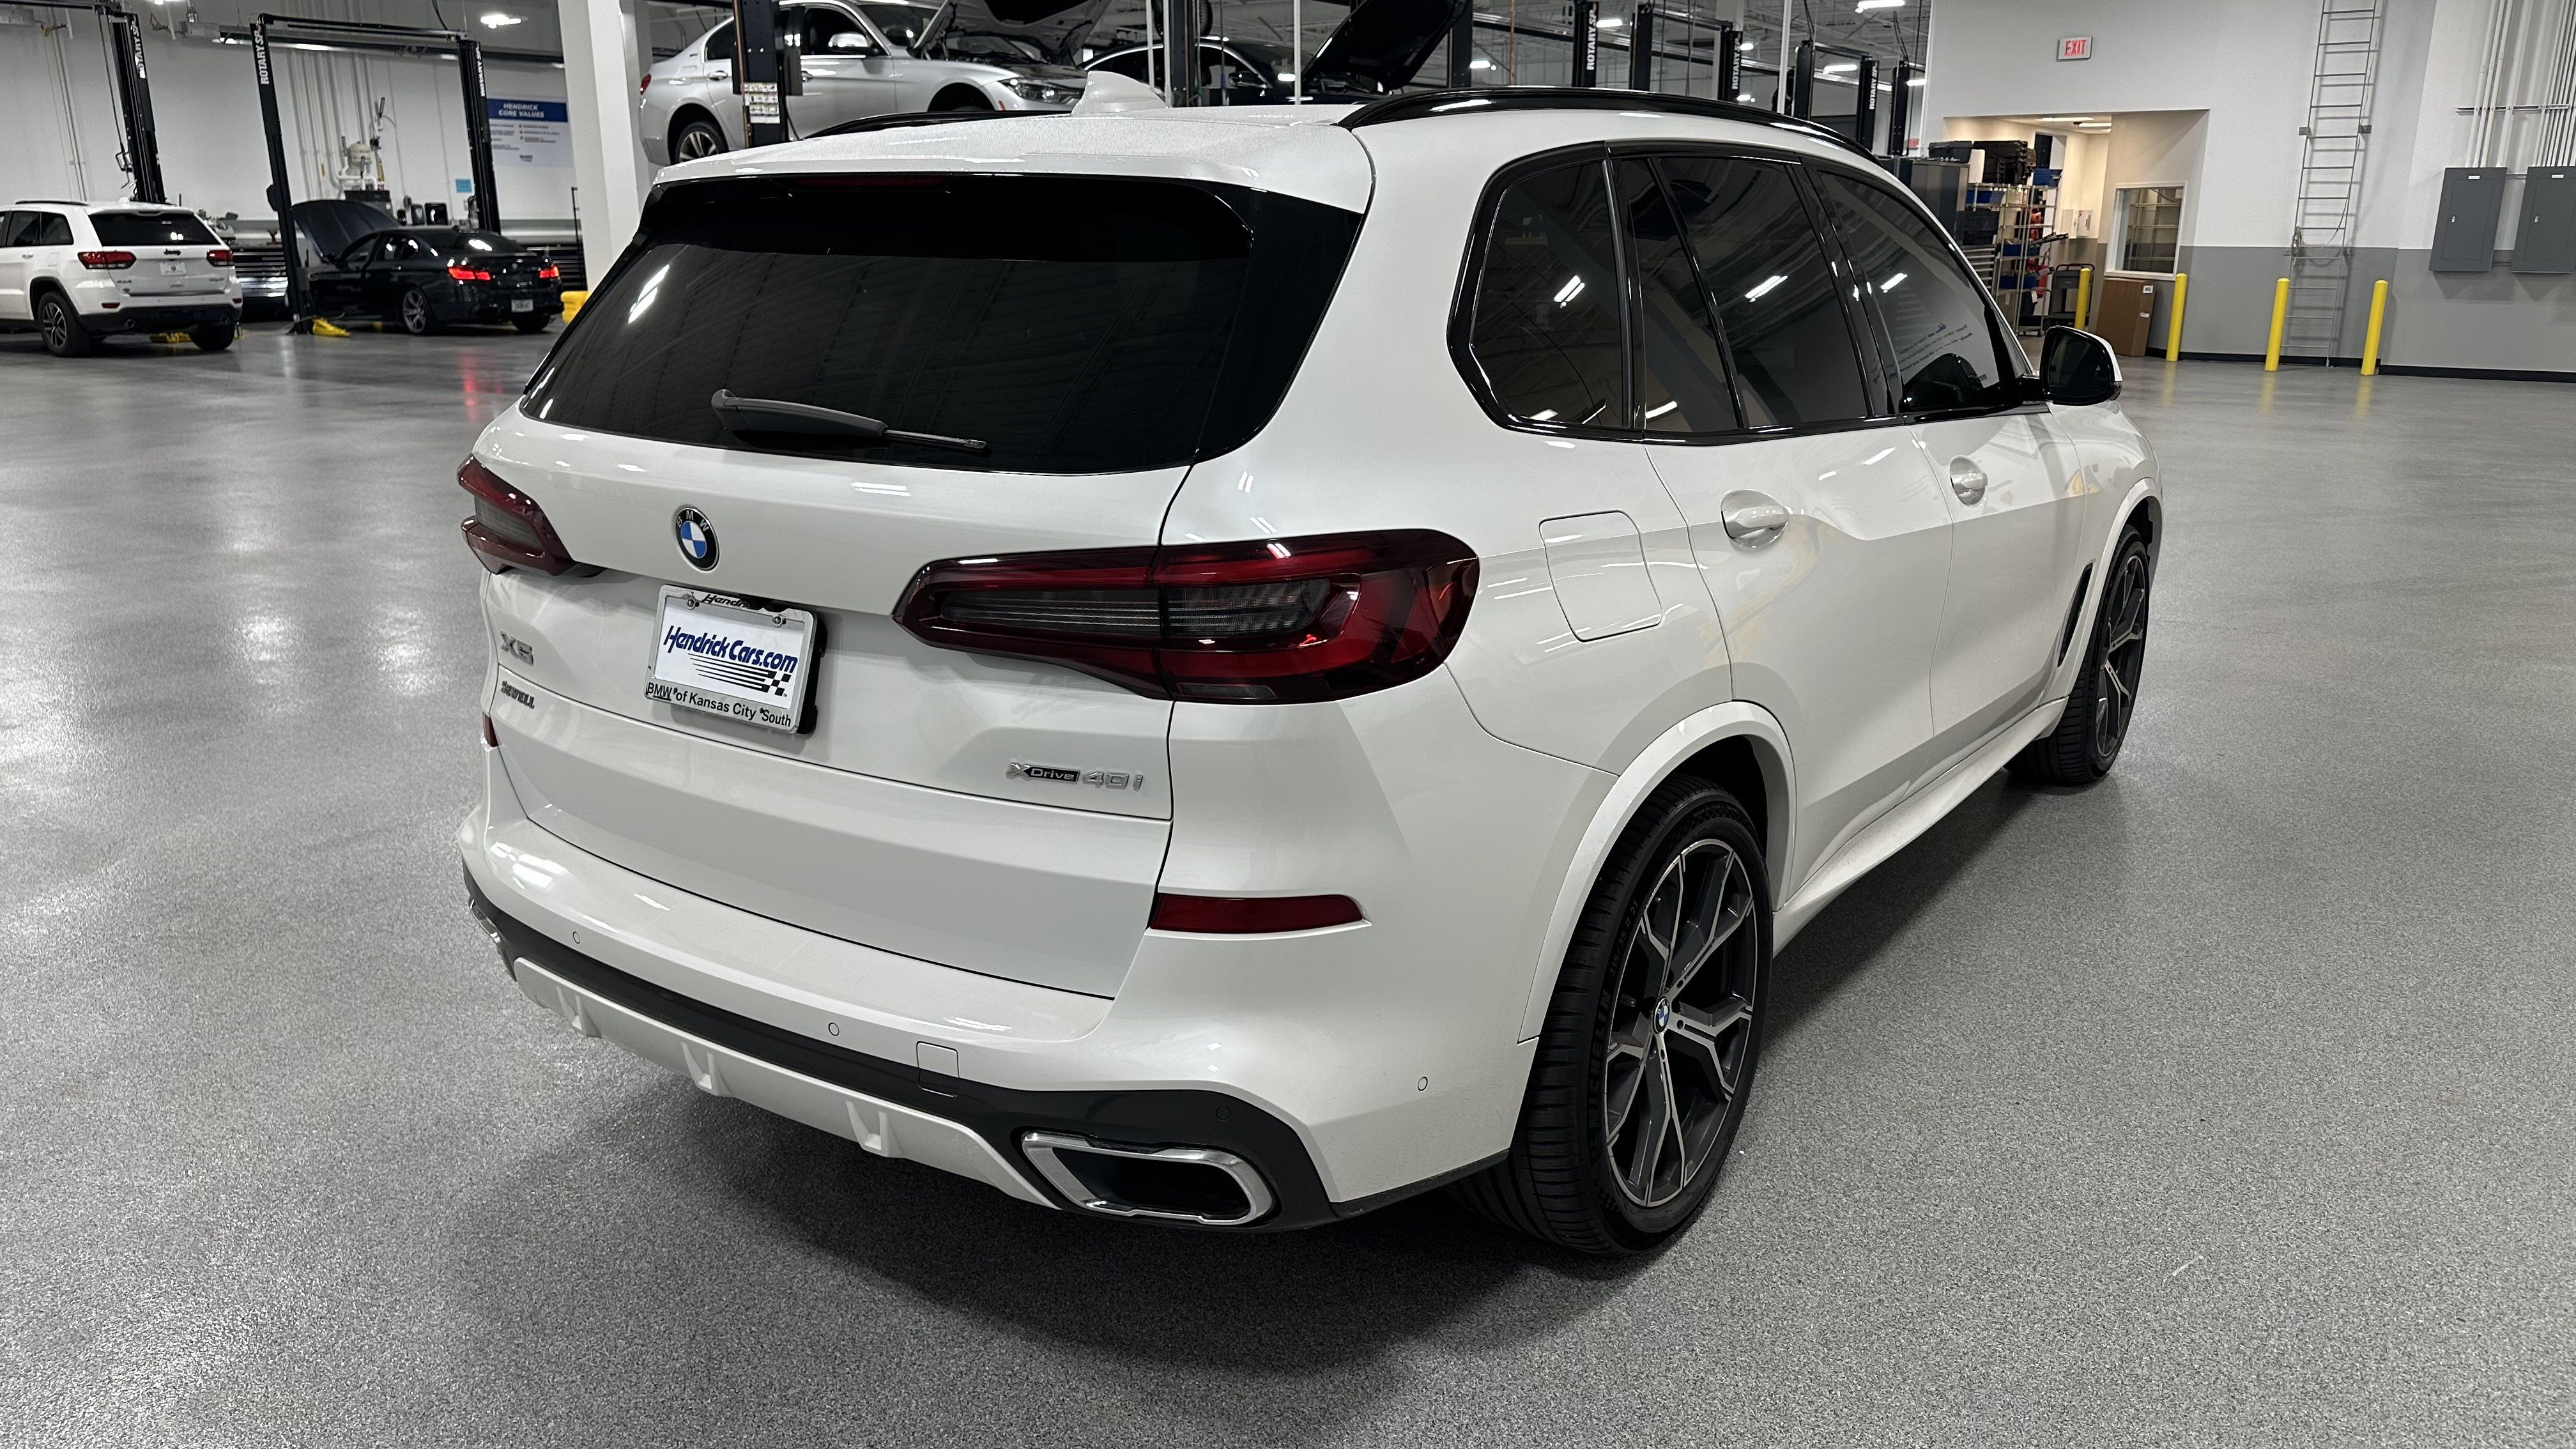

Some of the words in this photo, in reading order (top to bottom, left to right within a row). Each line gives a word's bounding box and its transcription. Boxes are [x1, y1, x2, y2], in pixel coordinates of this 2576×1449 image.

[256, 45, 269, 84] ROTARY
[1586, 26, 1596, 70] ROTARY
[2065, 40, 2086, 56] EXIT
[677, 510, 710, 532] BMW
[500, 631, 534, 665] X5
[647, 682, 672, 698] BMW
[676, 690, 688, 702] of
[689, 692, 730, 712] Kansas
[733, 703, 756, 721] City
[762, 708, 791, 727] South
[1625, 917, 1632, 929] R
[1630, 900, 1638, 916] 21
[1588, 989, 1611, 1128] MICHELIN
